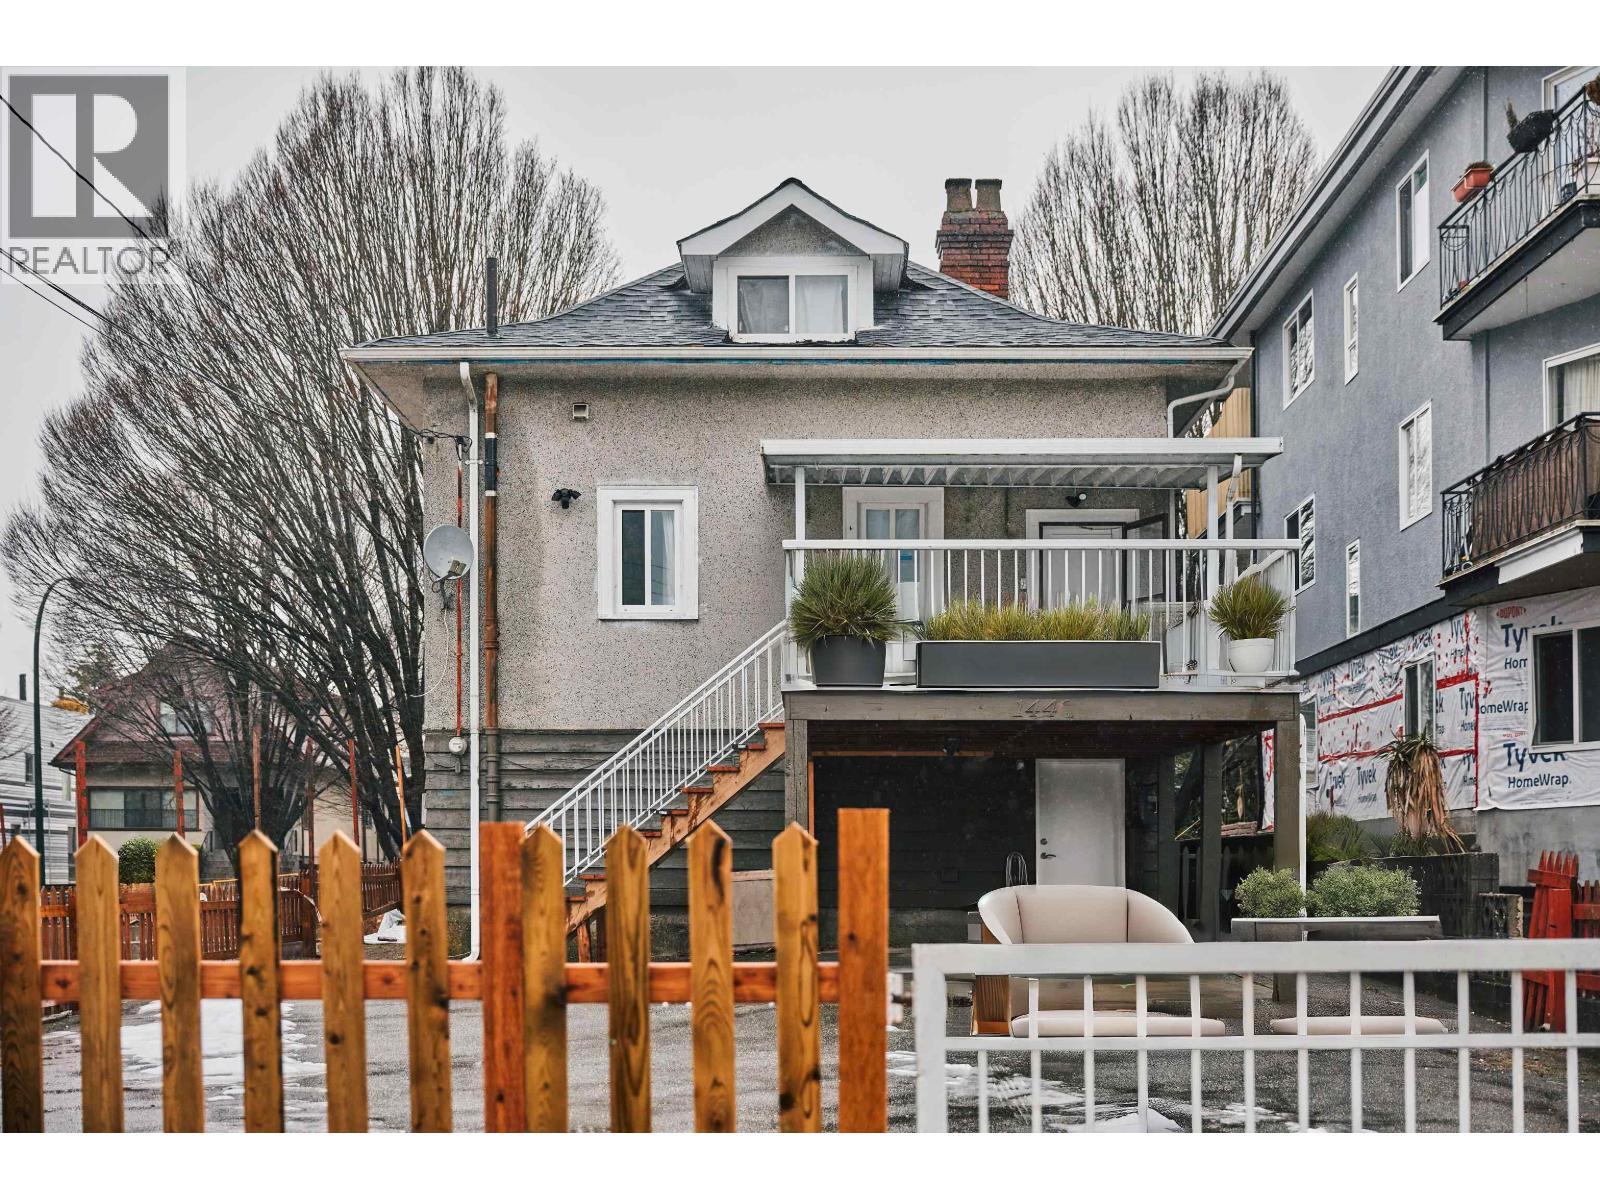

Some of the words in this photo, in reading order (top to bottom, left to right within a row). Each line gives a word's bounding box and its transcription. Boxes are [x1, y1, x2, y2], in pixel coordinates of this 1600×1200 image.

[1015, 698, 1073, 719] 144
[1459, 687, 1475, 716] Tyv
[1480, 700, 1528, 714] omeWrap
[1503, 742, 1566, 772] Tyvek
[1508, 773, 1569, 789] HomeWrap
